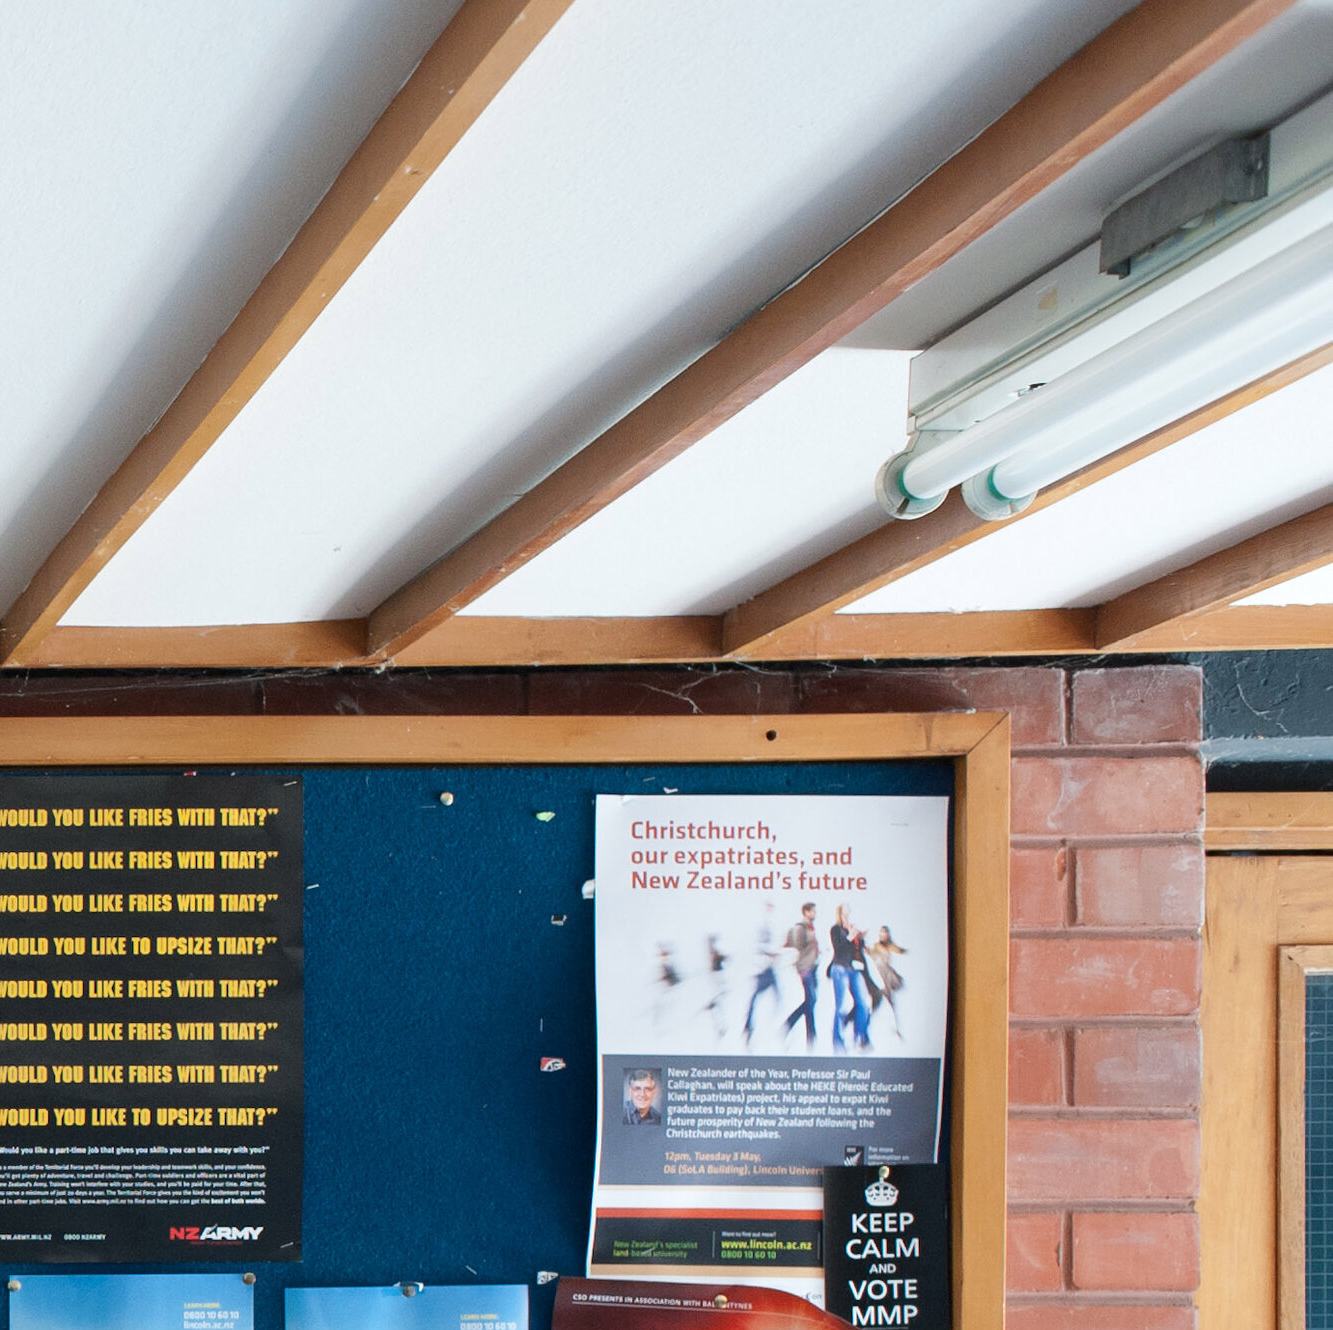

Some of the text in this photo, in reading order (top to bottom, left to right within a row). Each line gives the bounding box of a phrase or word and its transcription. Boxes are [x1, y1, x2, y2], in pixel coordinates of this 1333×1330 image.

[631, 820, 776, 842] Christchurch,
[631, 846, 851, 869] our expatriates, and
[632, 870, 867, 890] New Zealand's future
[53, 937, 85, 955] YOU
[91, 937, 126, 955] LIKE
[131, 937, 150, 954] TO
[157, 937, 212, 954] UPSIZE
[668, 1068, 689, 1077] New
[690, 1067, 736, 1077] Zealander
[738, 1068, 748, 1078] of
[750, 1068, 766, 1078] the
[791, 1069, 835, 1079] Professor
[850, 1069, 870, 1079] Paul
[852, 1212, 913, 1233] KEEP
[721, 1239, 812, 1251] www.lincoln.ac.nz
[846, 1237, 919, 1259] CALM
[869, 1263, 896, 1274] AND
[848, 1279, 917, 1300] VOTE
[852, 1305, 918, 1326] MMP
